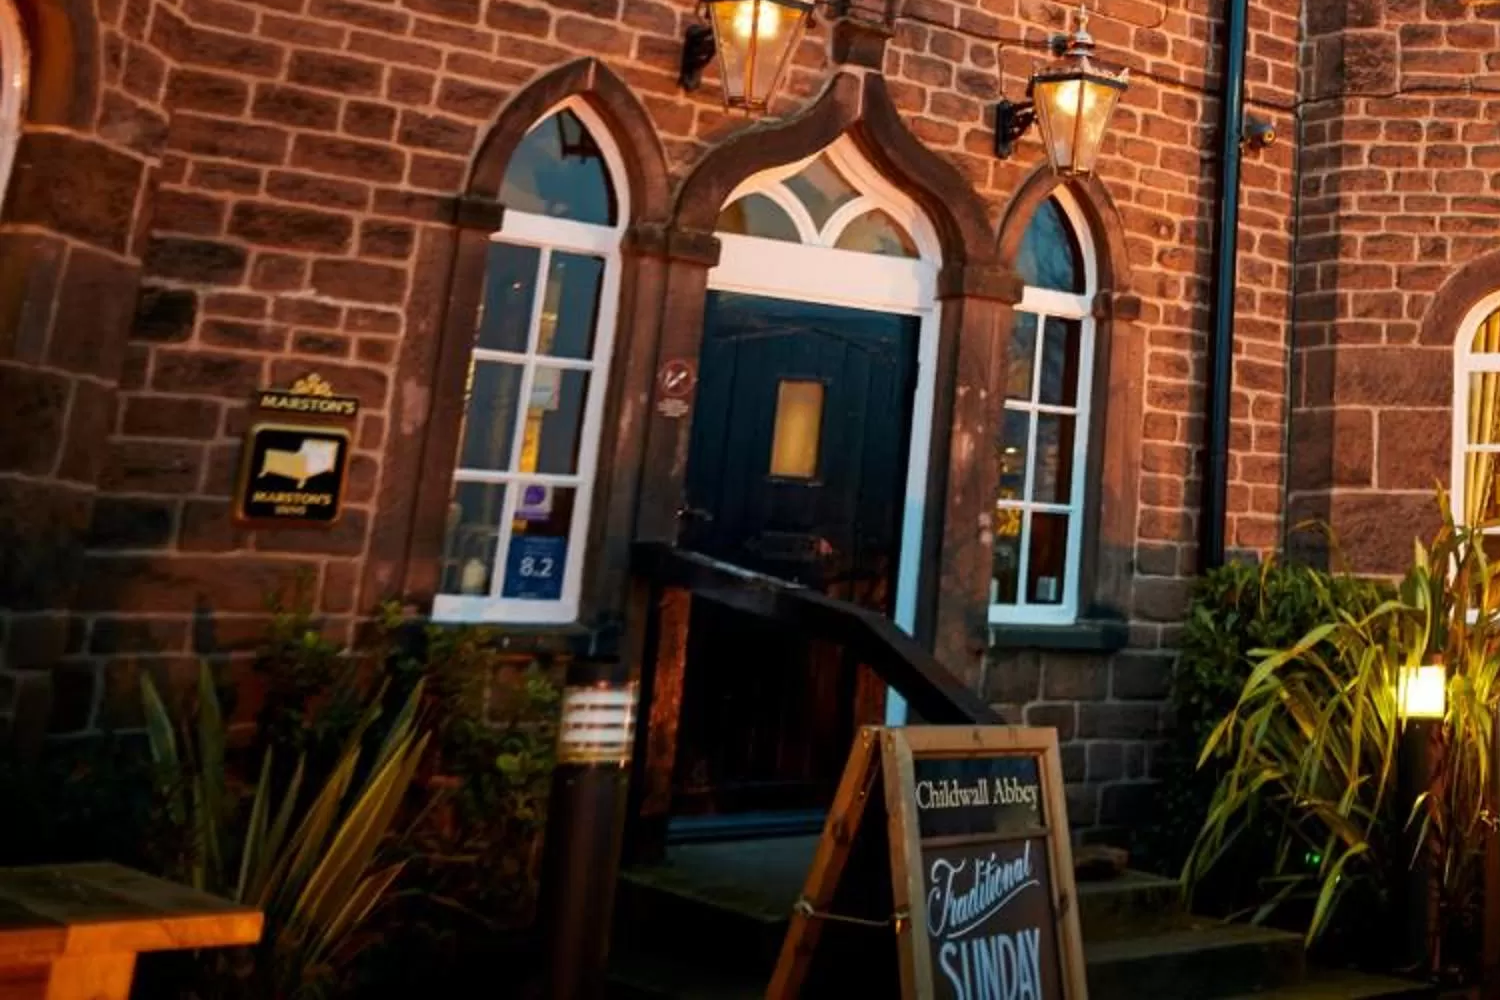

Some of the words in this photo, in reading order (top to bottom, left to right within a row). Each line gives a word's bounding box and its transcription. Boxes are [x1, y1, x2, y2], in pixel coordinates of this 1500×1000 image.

[260, 395, 356, 415] MARSTON'S
[519, 556, 554, 578] 8.2
[915, 779, 990, 809] Childwall
[993, 776, 1039, 811] Abbey
